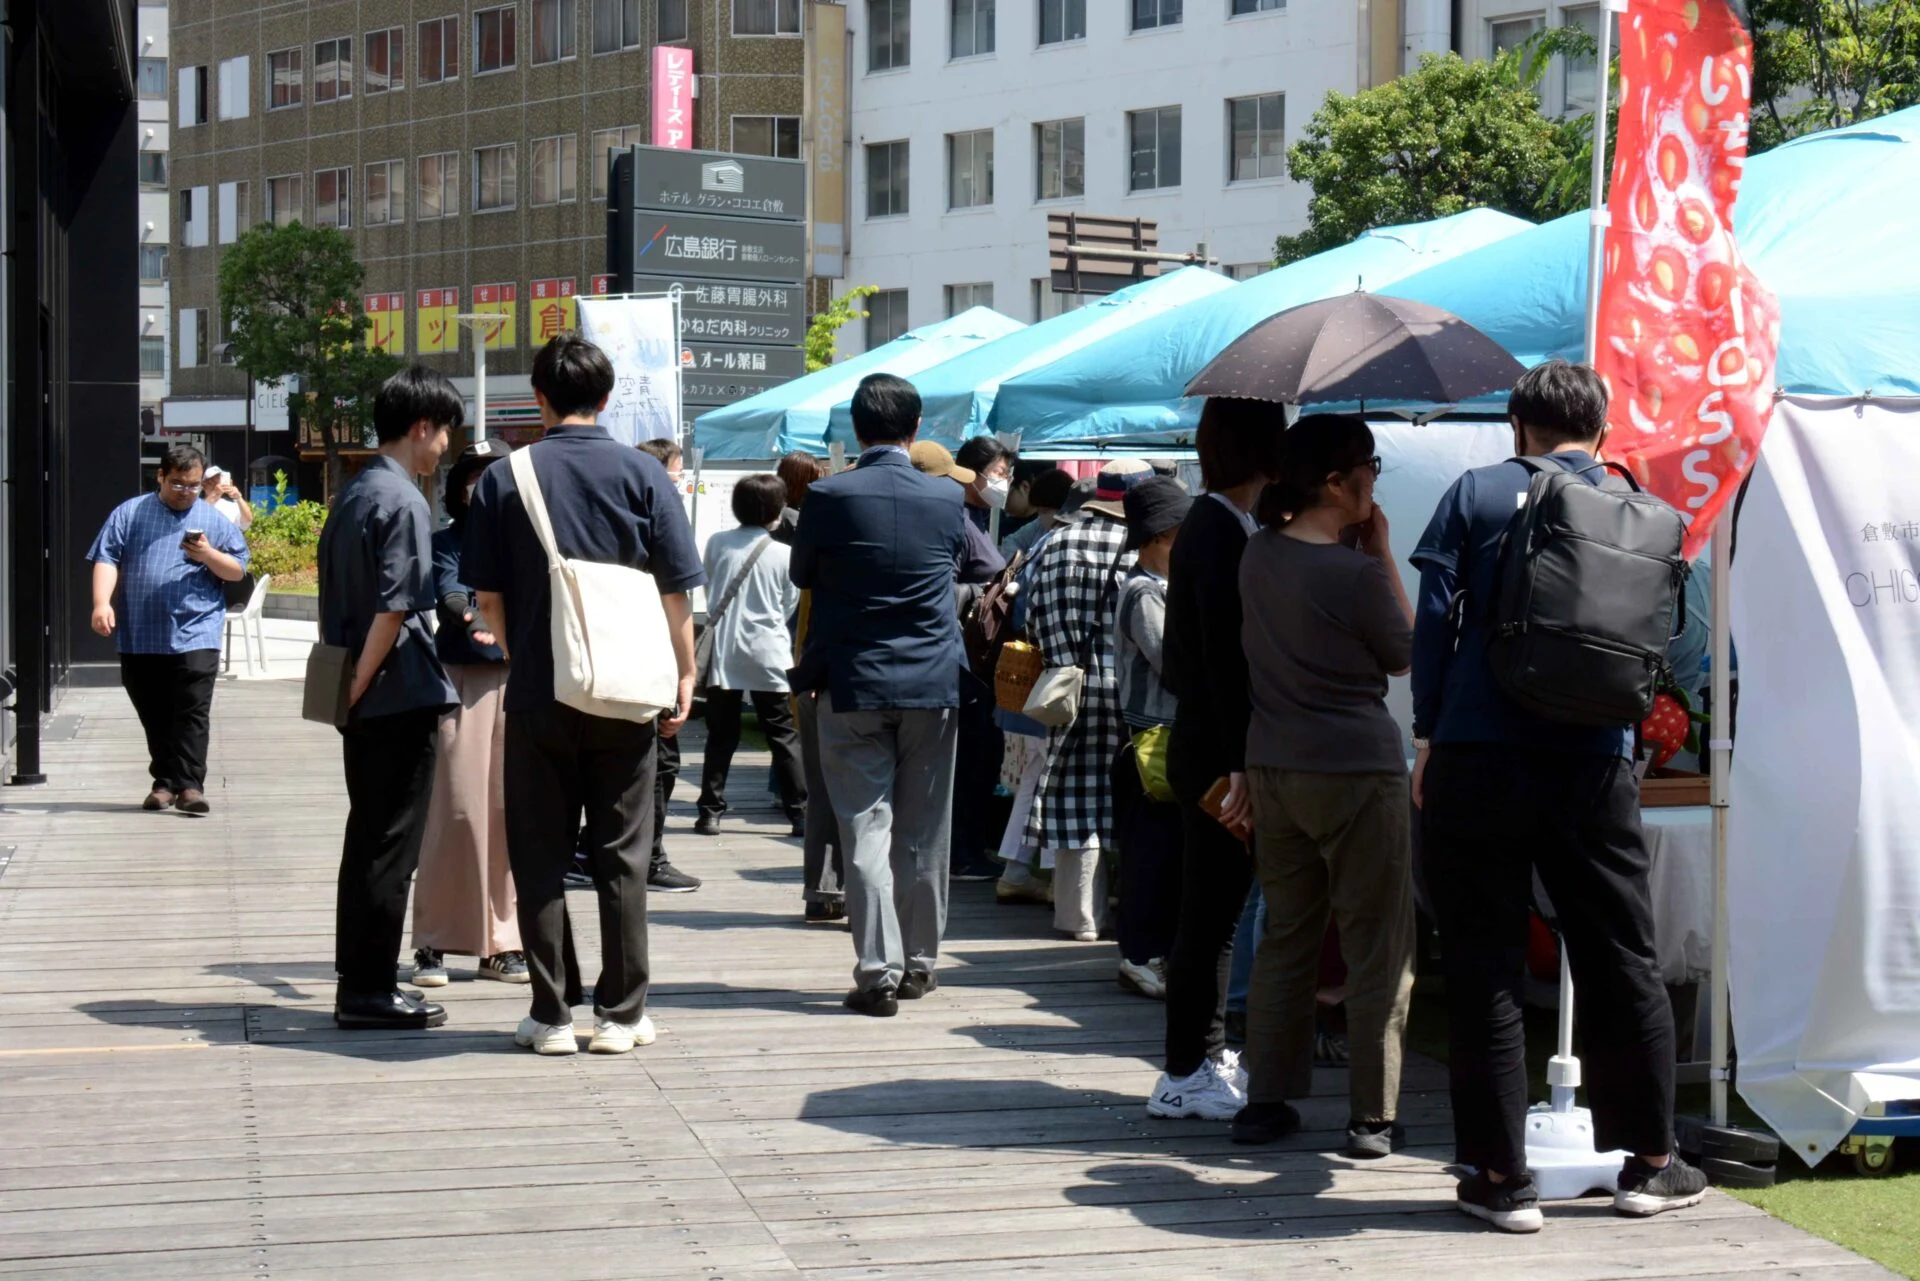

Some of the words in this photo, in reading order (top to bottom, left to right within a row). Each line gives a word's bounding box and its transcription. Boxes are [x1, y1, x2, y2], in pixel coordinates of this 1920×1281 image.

[667, 129, 684, 149] ア
[659, 190, 690, 205] ホテル
[664, 234, 737, 261] 広島銀行
[696, 285, 788, 308] 佐藤胃腸外科
[701, 351, 766, 370] オール薬局
[1860, 520, 1920, 542] 倉敷市
[1845, 568, 1920, 607] CHIG
